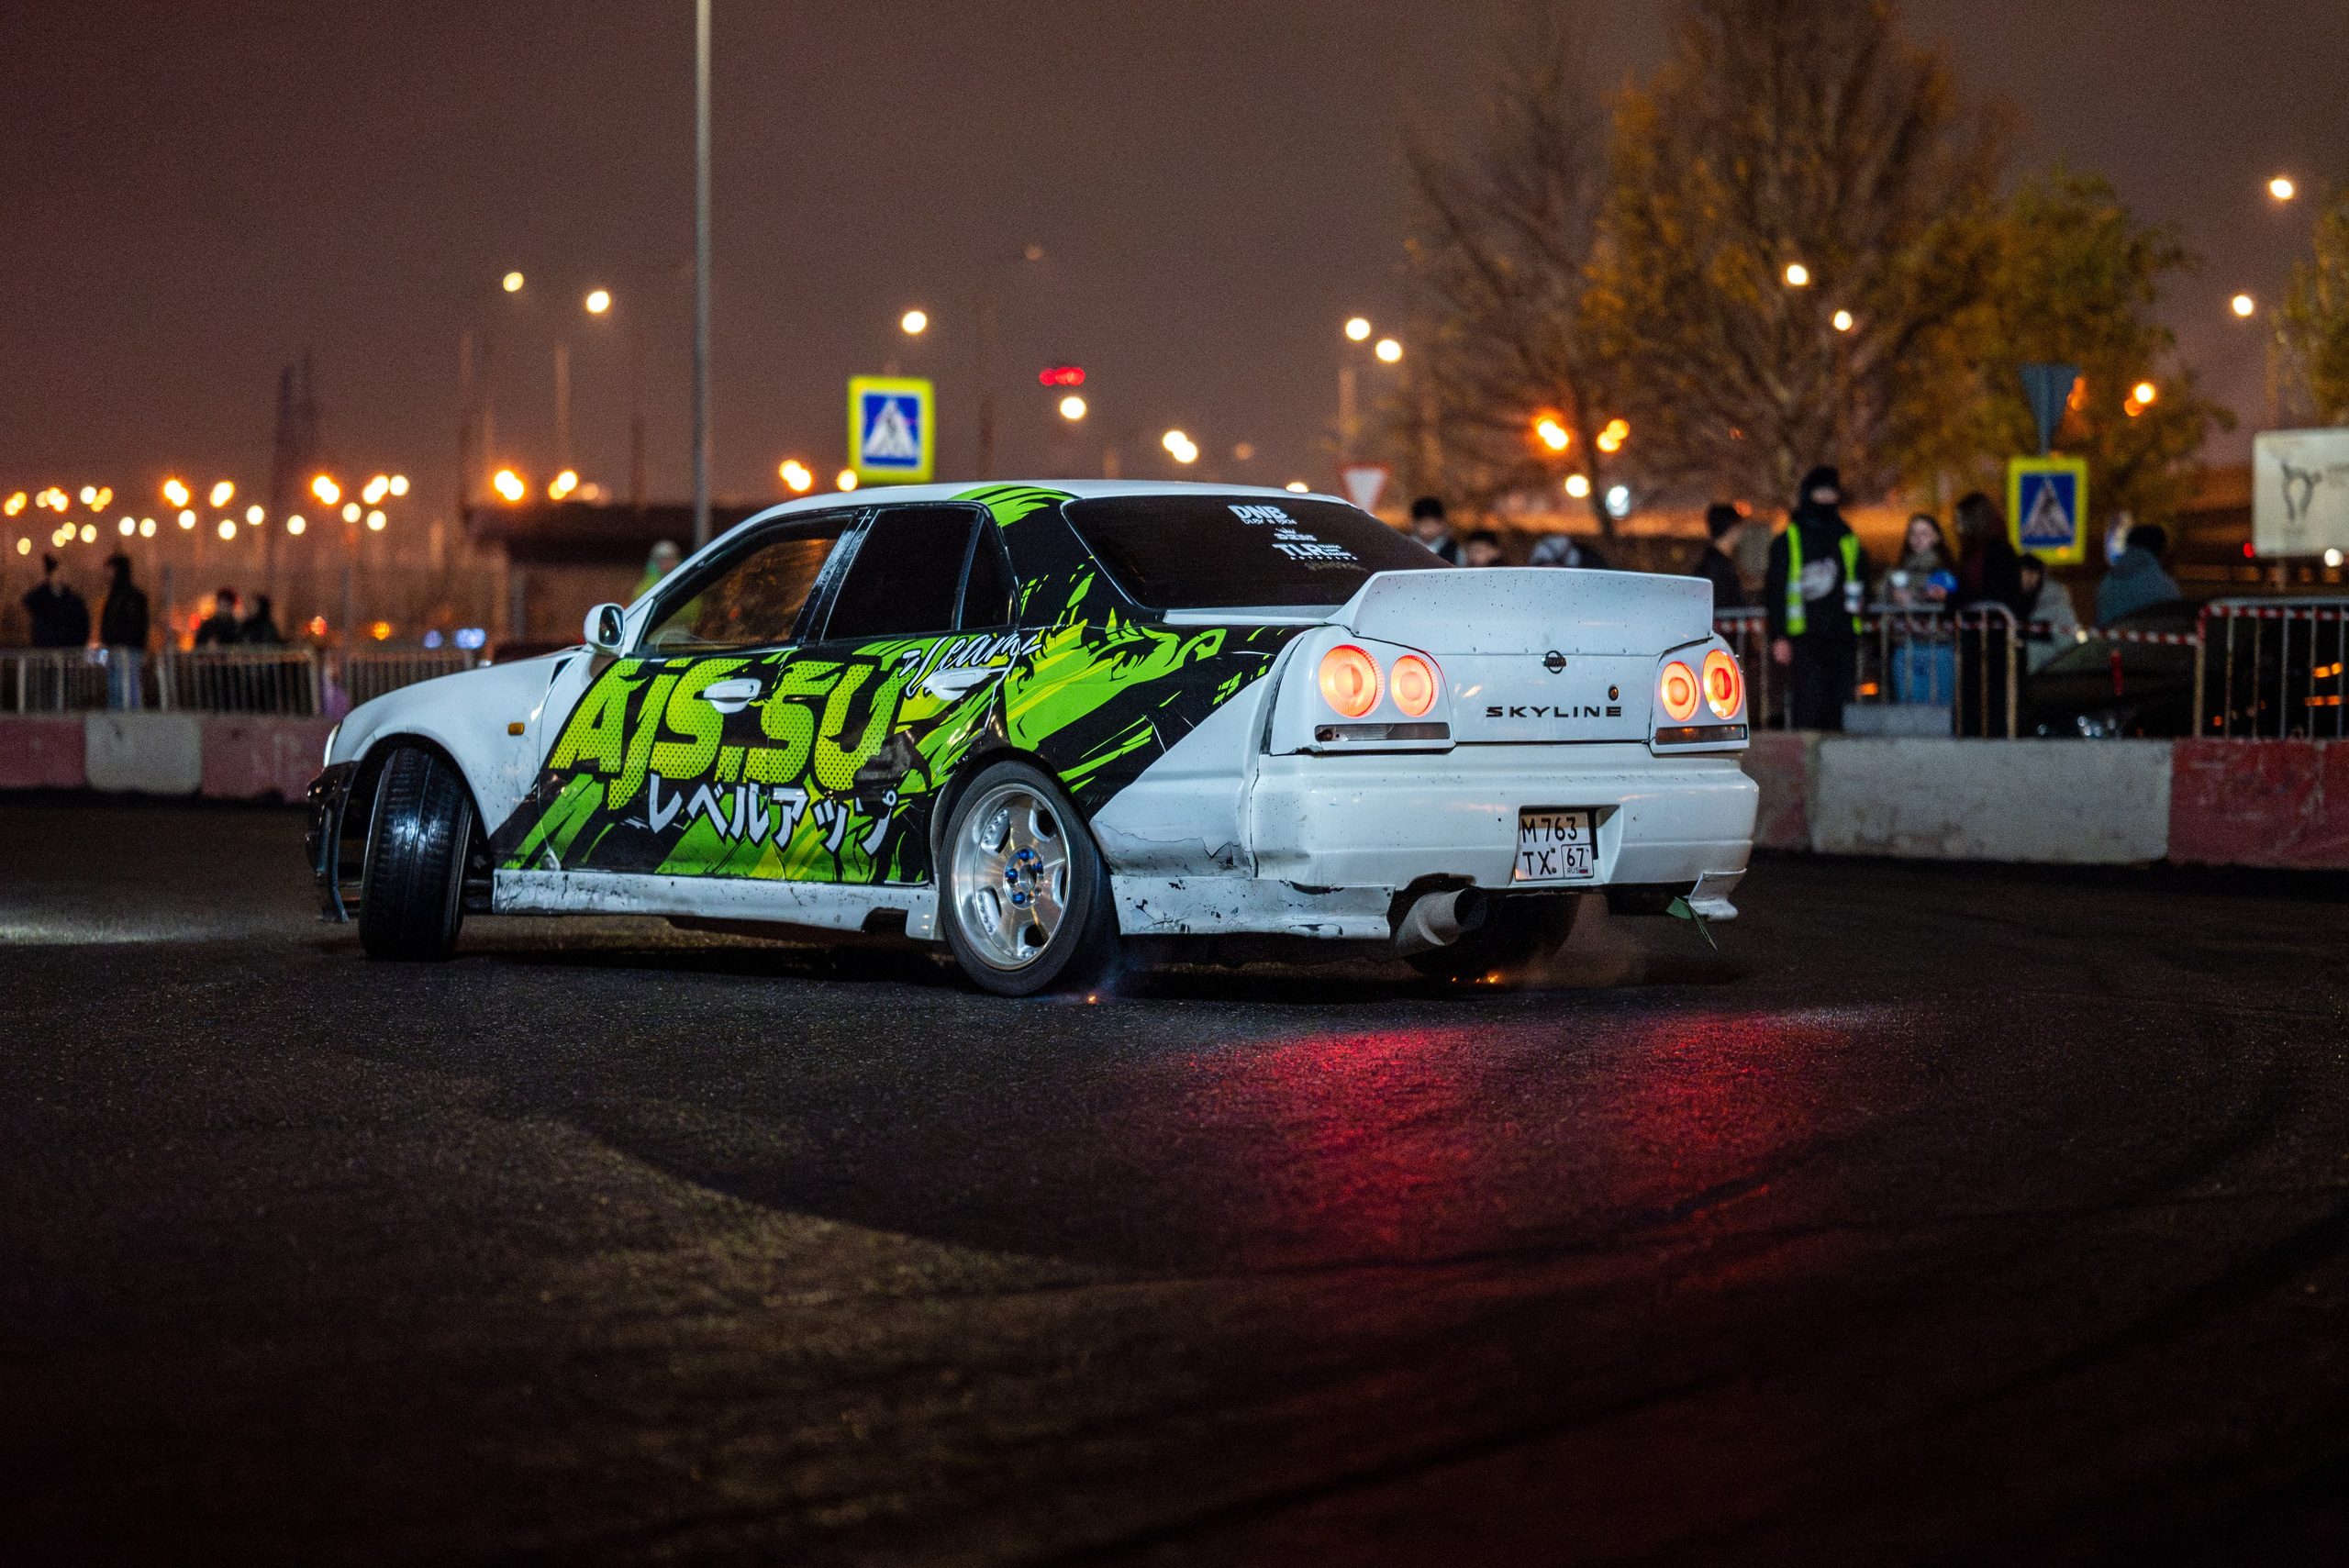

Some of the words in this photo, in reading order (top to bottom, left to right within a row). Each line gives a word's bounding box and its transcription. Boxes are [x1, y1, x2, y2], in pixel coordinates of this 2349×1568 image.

[1228, 506, 1287, 519] DNB
[1272, 544, 1330, 556] TLR
[1486, 706, 1621, 717] SKYLINE
[1541, 817, 1577, 841] 763
[1567, 848, 1584, 868] 67
